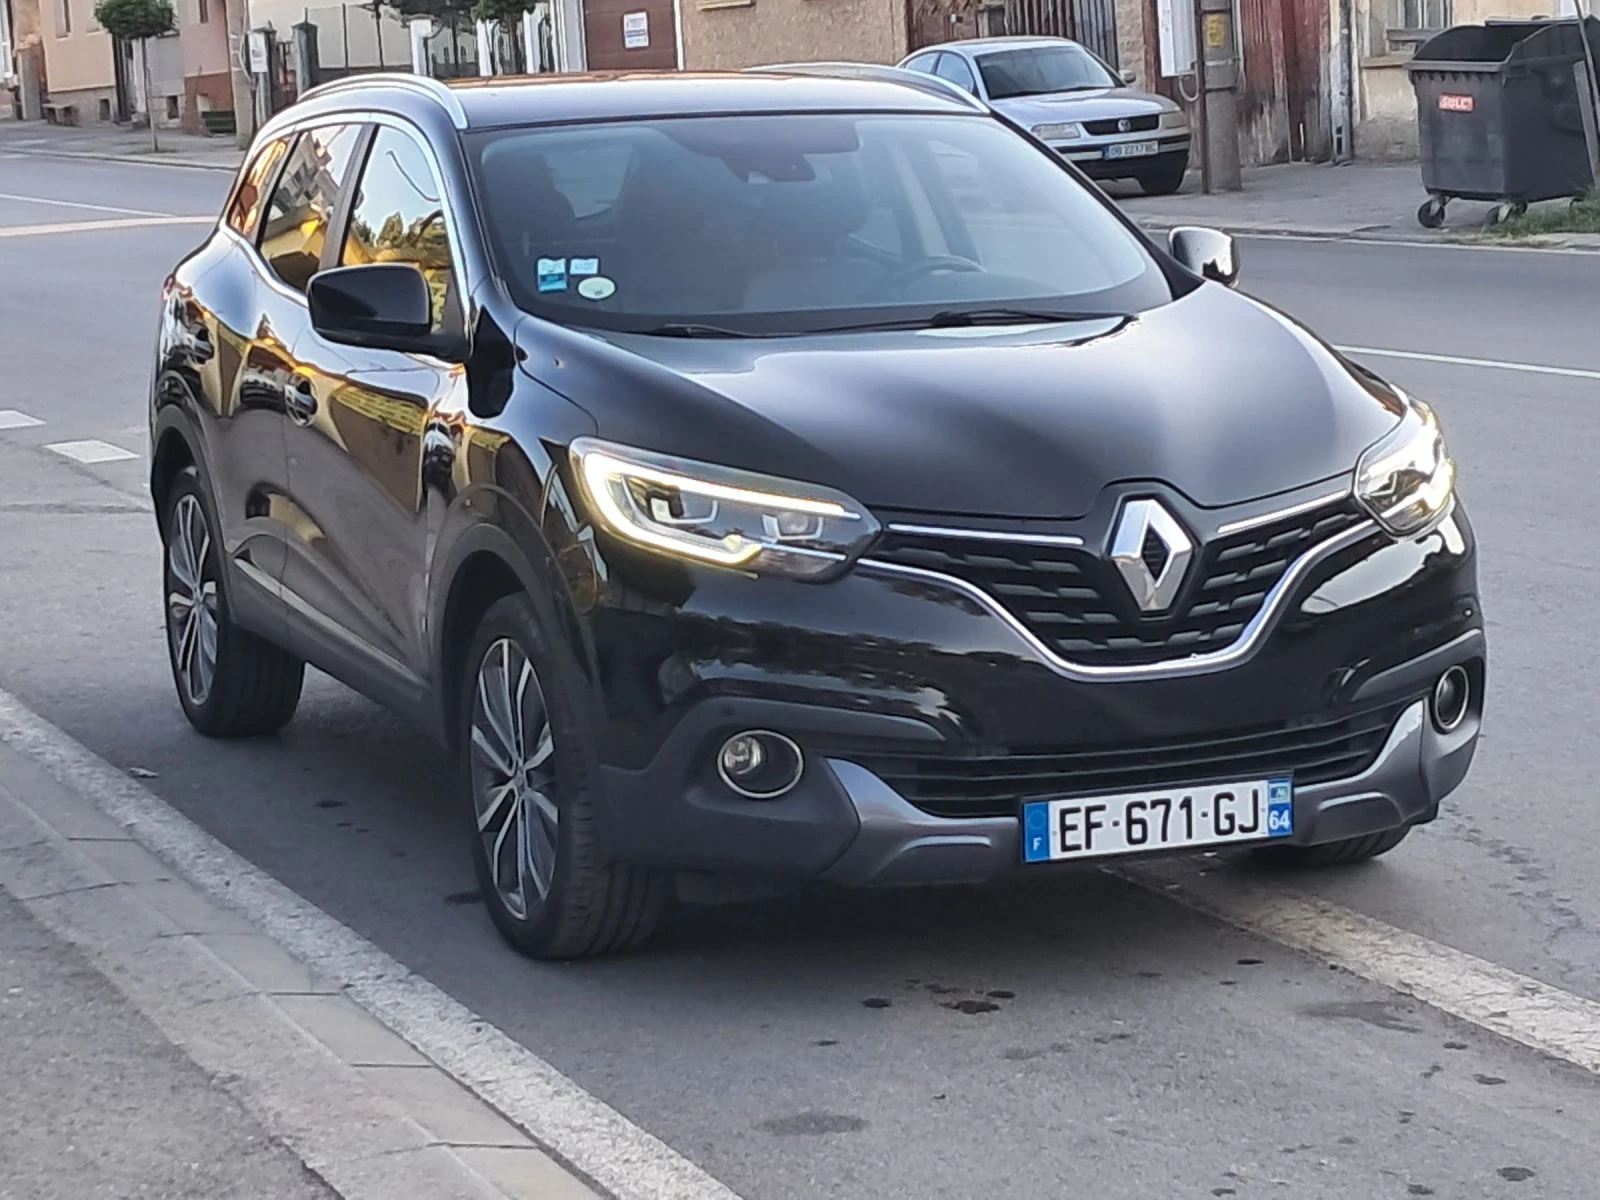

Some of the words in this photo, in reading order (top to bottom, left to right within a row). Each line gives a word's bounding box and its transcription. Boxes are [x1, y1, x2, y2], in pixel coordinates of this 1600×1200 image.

[1059, 789, 1259, 852] EF-671-GJ
[1269, 809, 1290, 830] 64
[1033, 837, 1041, 850] F
